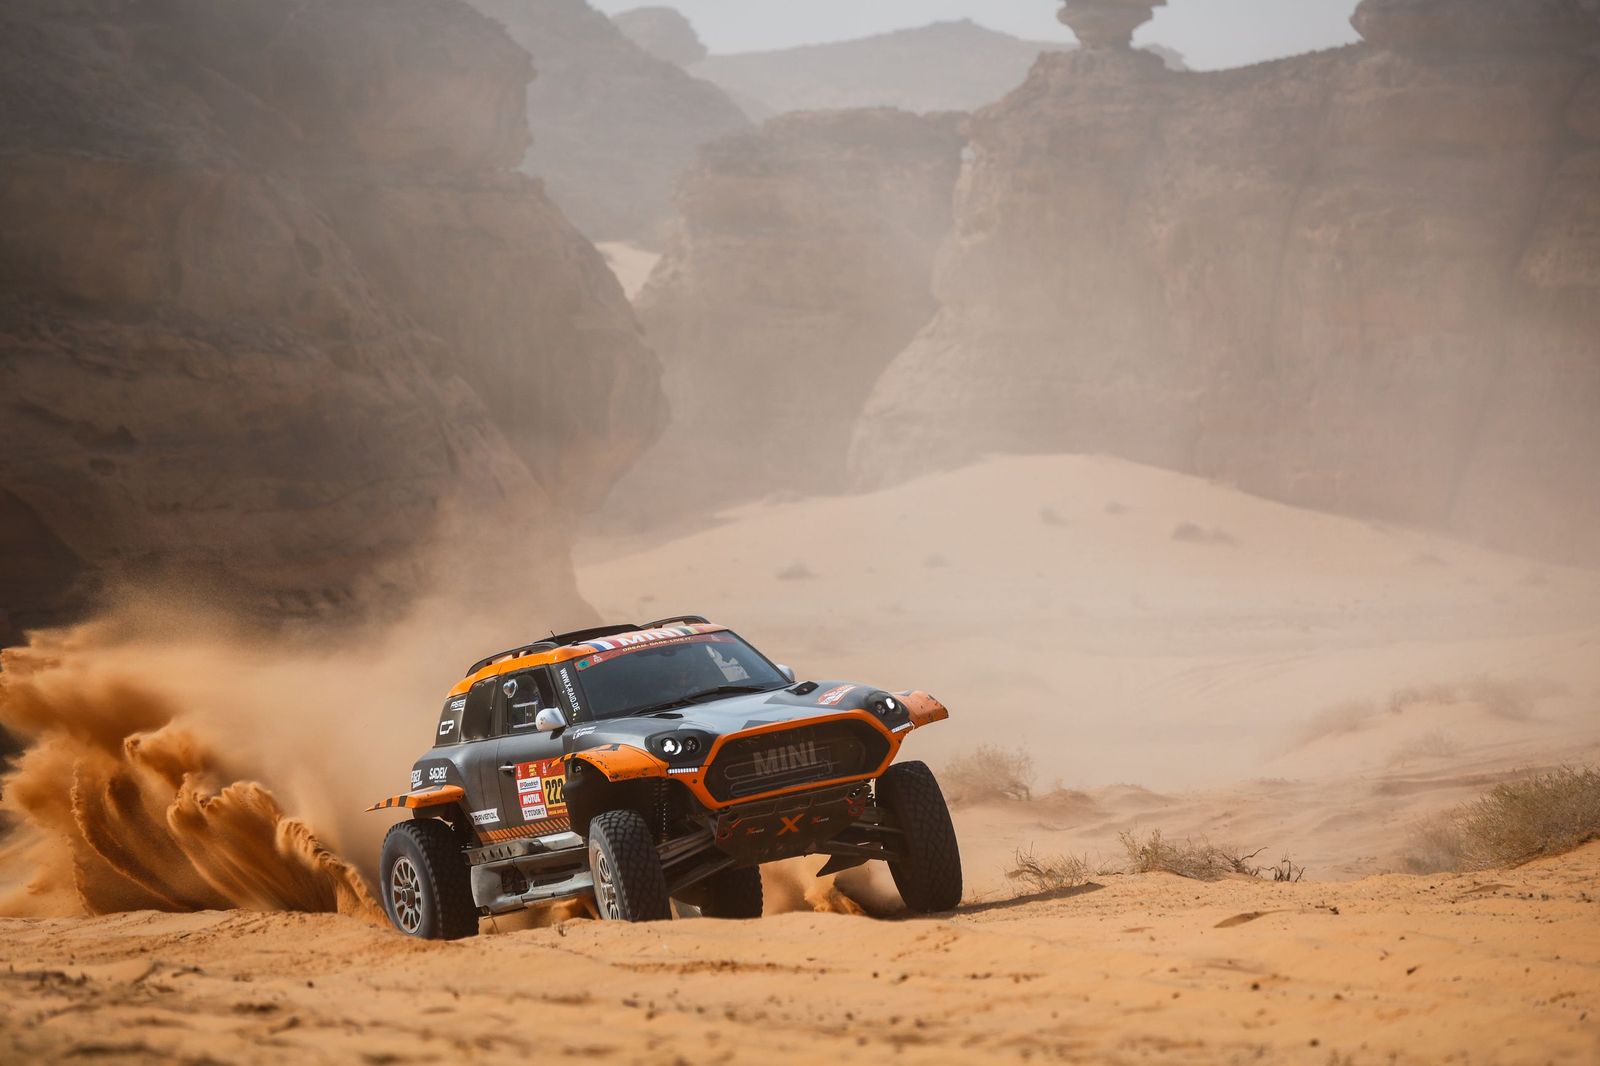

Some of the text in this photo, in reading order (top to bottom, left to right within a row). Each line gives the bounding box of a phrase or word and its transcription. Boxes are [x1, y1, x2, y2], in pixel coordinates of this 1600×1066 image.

[618, 630, 685, 645] MINI
[753, 741, 817, 775] MINI
[522, 793, 541, 805] MOTUL
[545, 778, 565, 805] 222
